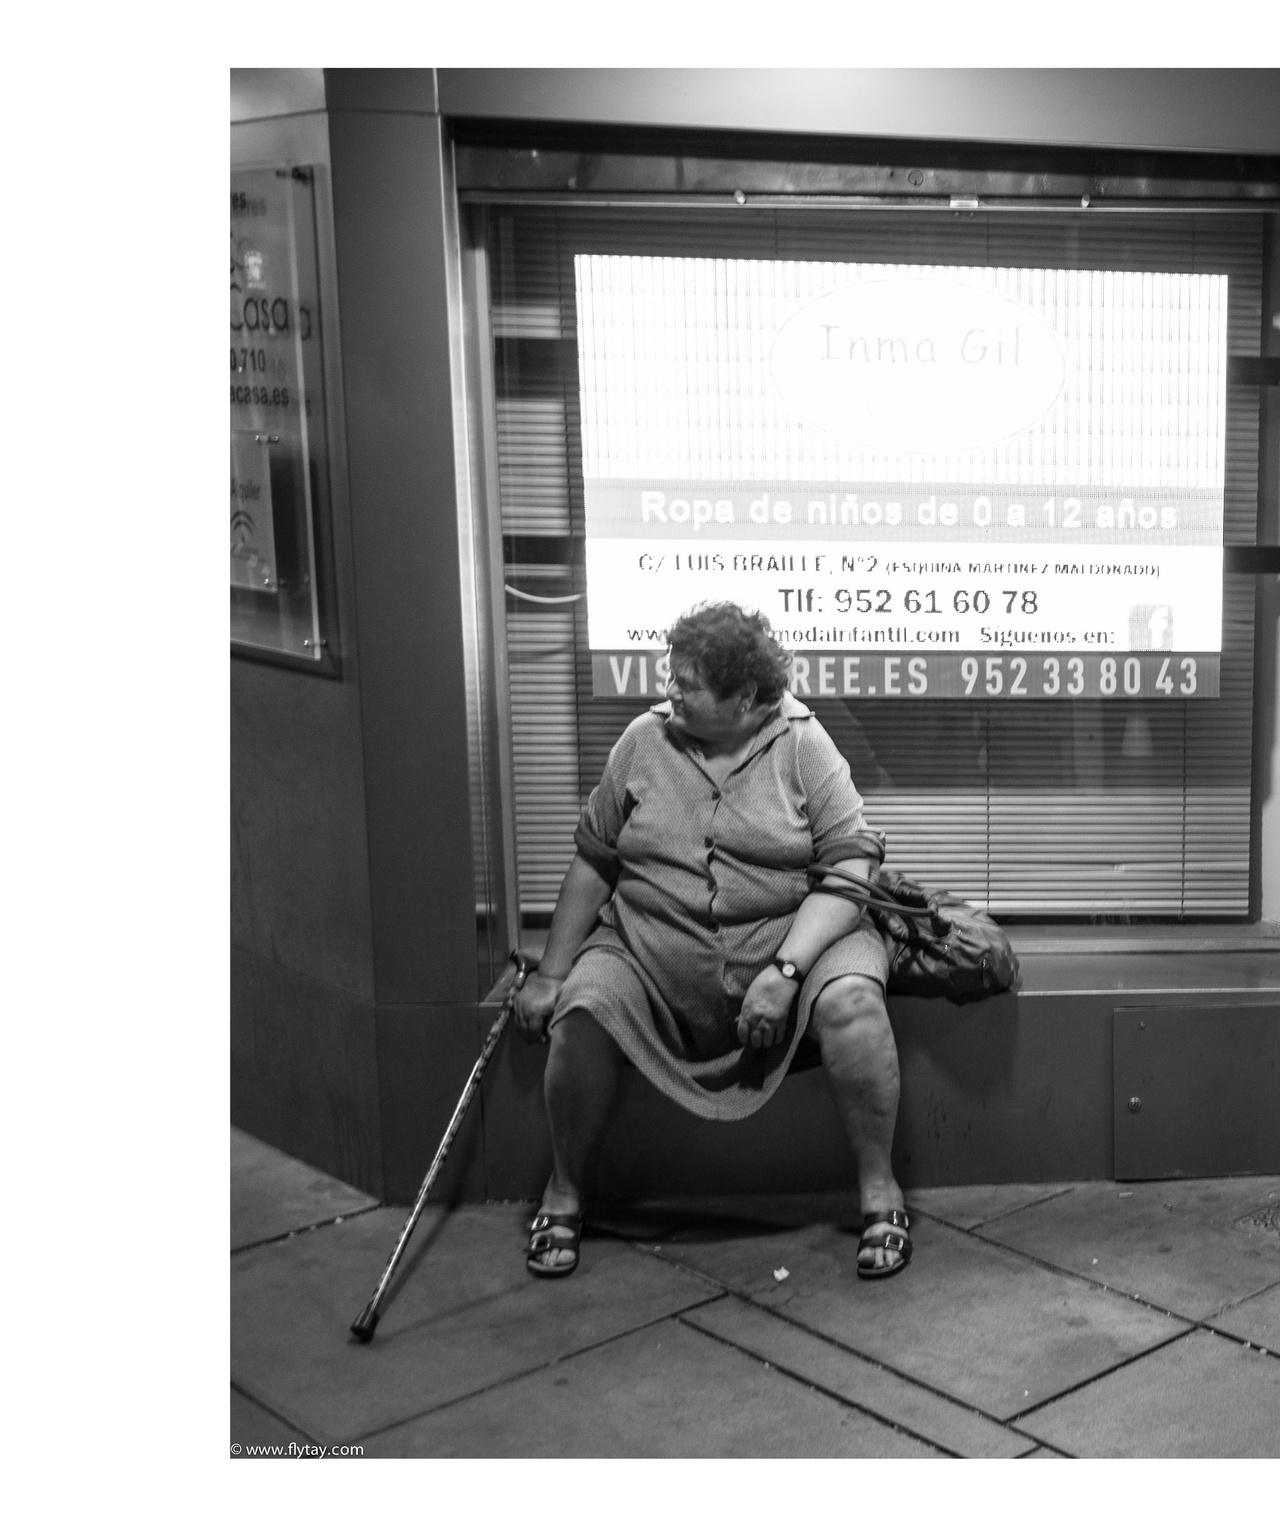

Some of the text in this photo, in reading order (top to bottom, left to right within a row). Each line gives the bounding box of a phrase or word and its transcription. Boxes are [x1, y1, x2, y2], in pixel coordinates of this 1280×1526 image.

[820, 325, 1022, 367] Inma Gil
[641, 490, 1178, 531] Ropa de niños de 0 a 12 años
[639, 553, 665, 575] C/
[676, 554, 724, 571] LUIS
[778, 588, 1038, 614] Tlf: 952 61 60 78
[962, 657, 1027, 695] 952
[1044, 657, 1084, 695] 33
[1100, 657, 1141, 695] 80
[1156, 657, 1198, 695] 43
